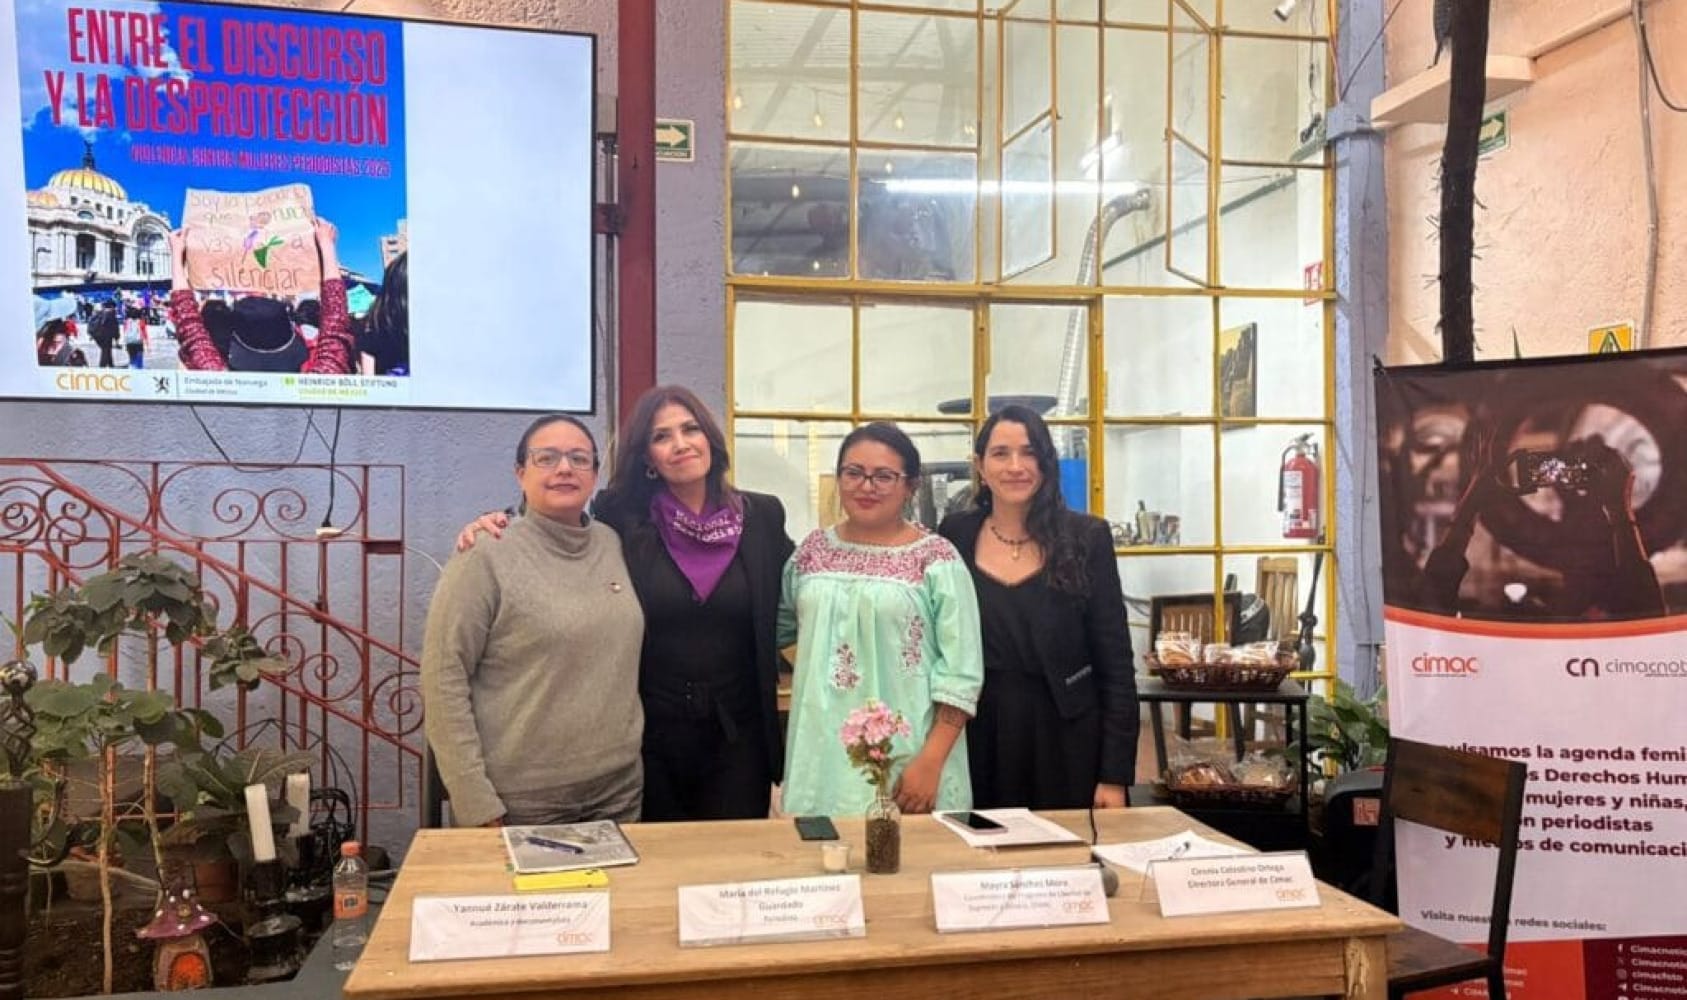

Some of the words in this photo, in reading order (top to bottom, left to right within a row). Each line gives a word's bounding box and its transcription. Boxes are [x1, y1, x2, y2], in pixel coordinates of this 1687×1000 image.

[67, 7, 169, 69] ENTRE
[178, 15, 214, 73] EL
[222, 19, 387, 86] DISCURSO
[44, 69, 65, 126] Y
[76, 72, 115, 129] LA
[125, 75, 387, 147] DESPROTECCIÓN
[211, 261, 303, 291] silenciar
[56, 369, 132, 392] cimac
[1412, 652, 1479, 673] cimac
[1566, 657, 1600, 678] cn
[1537, 744, 1554, 758] la
[1559, 747, 1636, 762] agenda
[1544, 768, 1640, 784] Derechos
[1526, 791, 1606, 808] mujeres
[1611, 796, 1624, 811] y
[1541, 814, 1654, 832] periodistas
[1445, 834, 1457, 849] y
[1539, 838, 1564, 850] de
[1420, 909, 1455, 922] Visita
[1515, 917, 1549, 928] redes
[1552, 919, 1607, 932] sociales:
